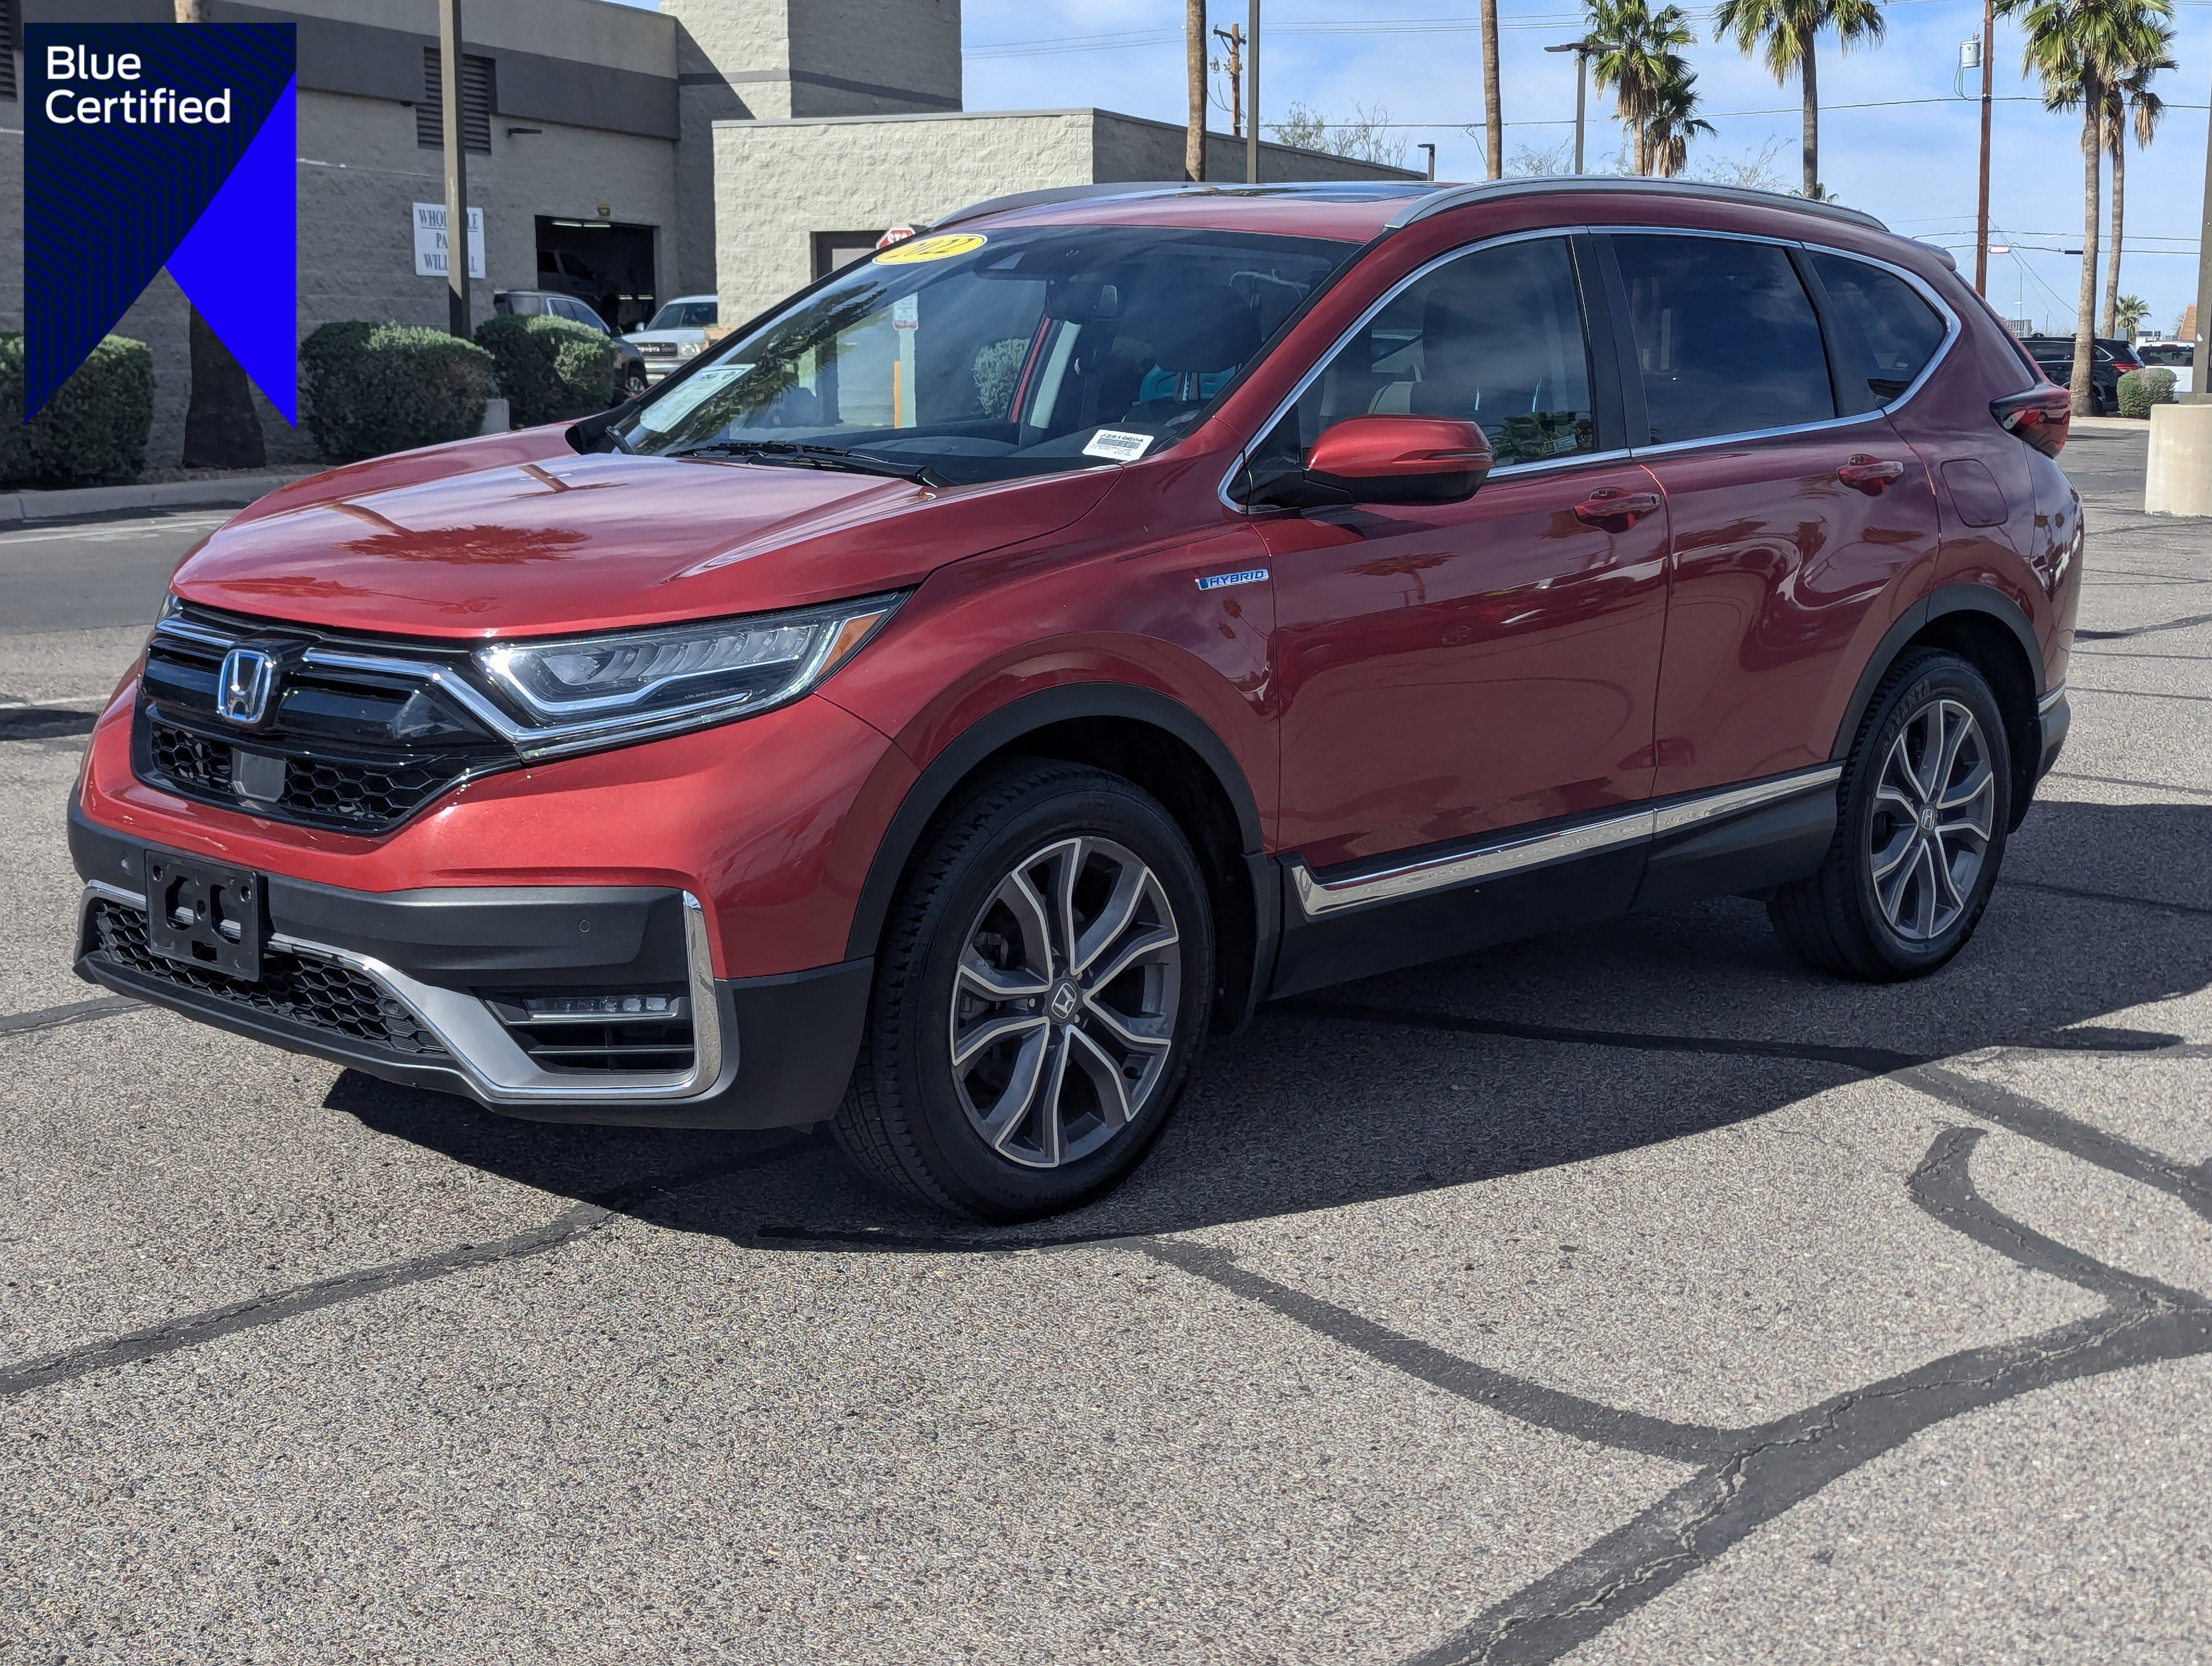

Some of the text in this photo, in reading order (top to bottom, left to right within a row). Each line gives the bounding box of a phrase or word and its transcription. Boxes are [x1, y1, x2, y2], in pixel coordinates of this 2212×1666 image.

[419, 209, 478, 229] WHOLE
[888, 233, 908, 244] STO
[1210, 571, 1264, 586] HYBRID
